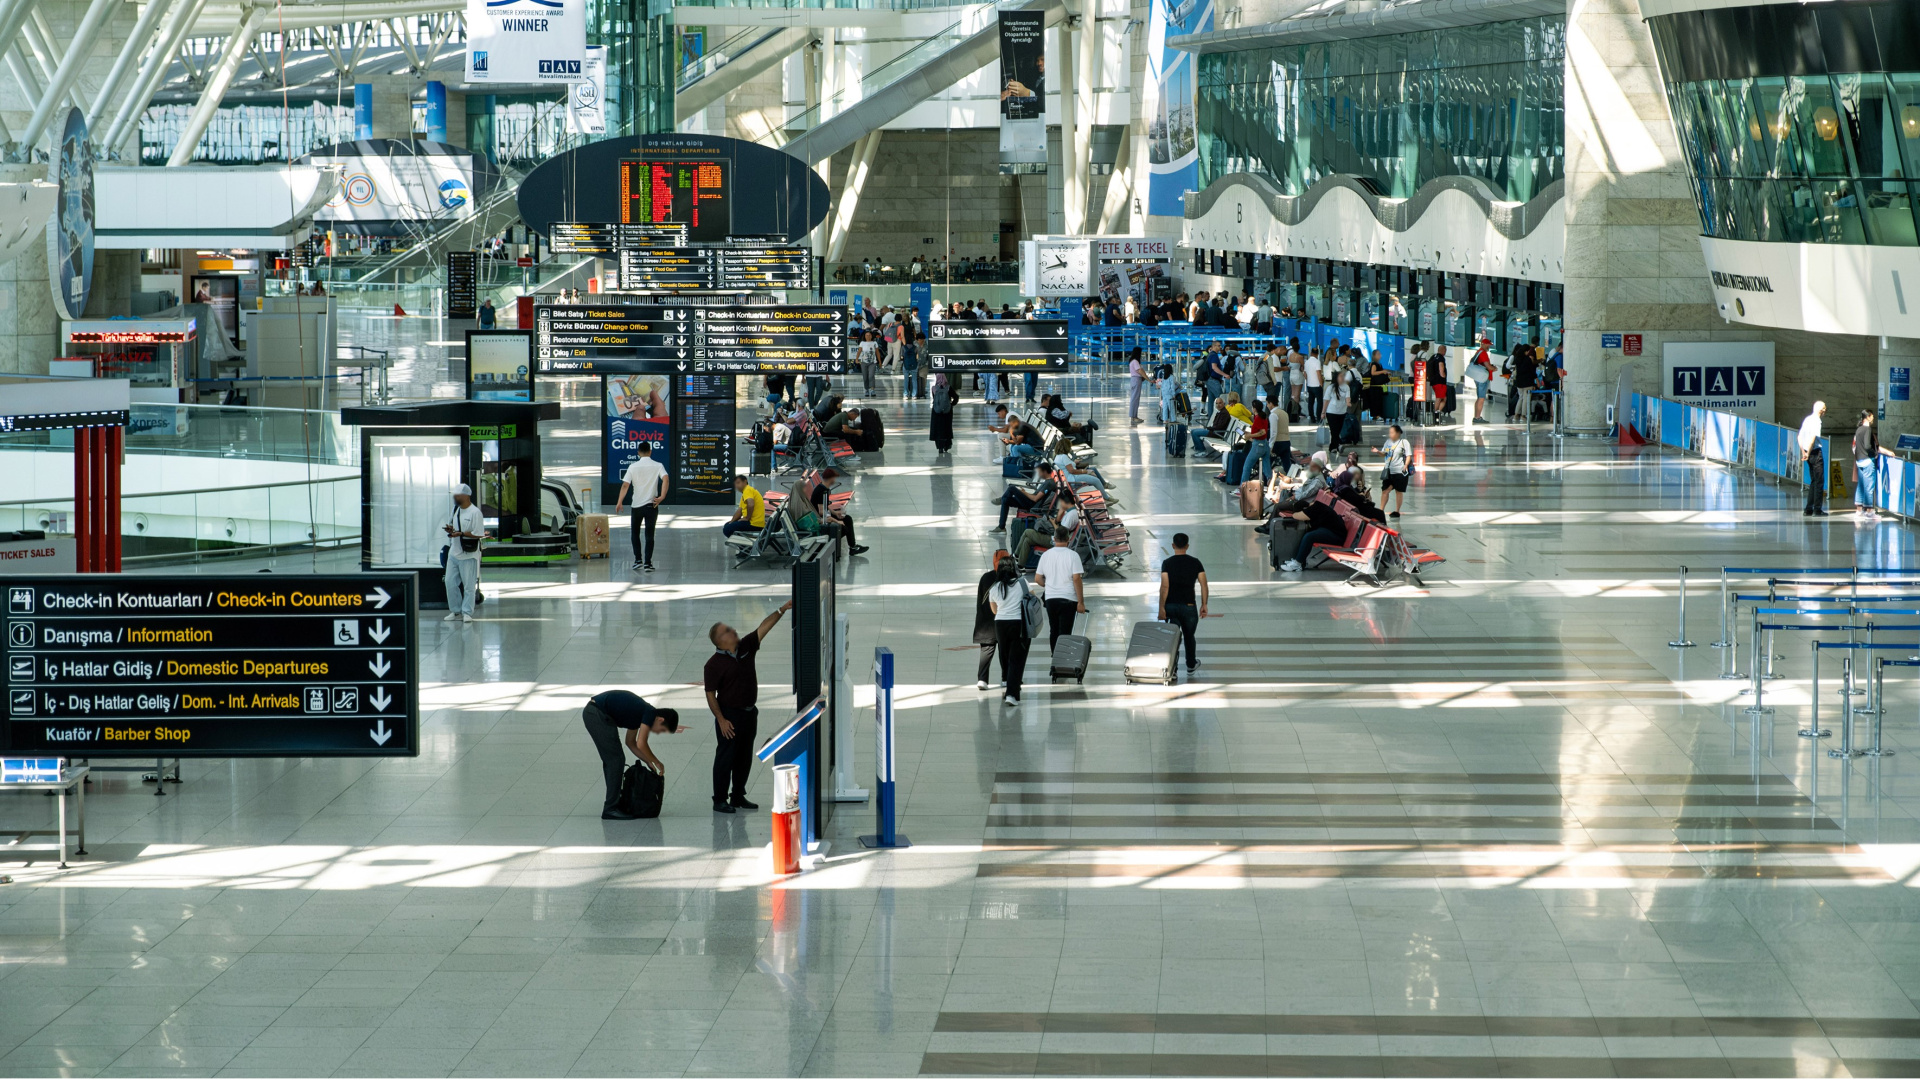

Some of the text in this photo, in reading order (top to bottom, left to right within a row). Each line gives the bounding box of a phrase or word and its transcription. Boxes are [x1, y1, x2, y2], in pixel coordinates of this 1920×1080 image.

[502, 19, 549, 32] WINNER
[474, 52, 487, 69] ACI
[540, 62, 580, 72] TAV
[1237, 203, 1242, 224] B
[1124, 243, 1133, 254] &
[1136, 243, 1168, 253] TEKEL
[568, 311, 584, 319] Satış
[1678, 371, 1760, 392] TAV
[629, 430, 664, 441] Döviz
[0, 548, 55, 560] TICKET SALES
[43, 591, 362, 609] Check-in Kontuarları / Check-in Counters
[44, 627, 213, 647] Danışma / Information
[44, 659, 329, 680] İç Hatlar Gidiş / Domestic Departures
[44, 692, 56, 713] İç
[68, 695, 91, 713] Dış
[94, 695, 134, 710] Hatlar
[137, 694, 170, 713] Geliş
[173, 694, 179, 709] /
[182, 694, 216, 708] Dom.
[228, 694, 248, 708] Int.
[251, 693, 300, 708] Arrivals
[46, 727, 191, 743] Kuaför / Barber Shop
